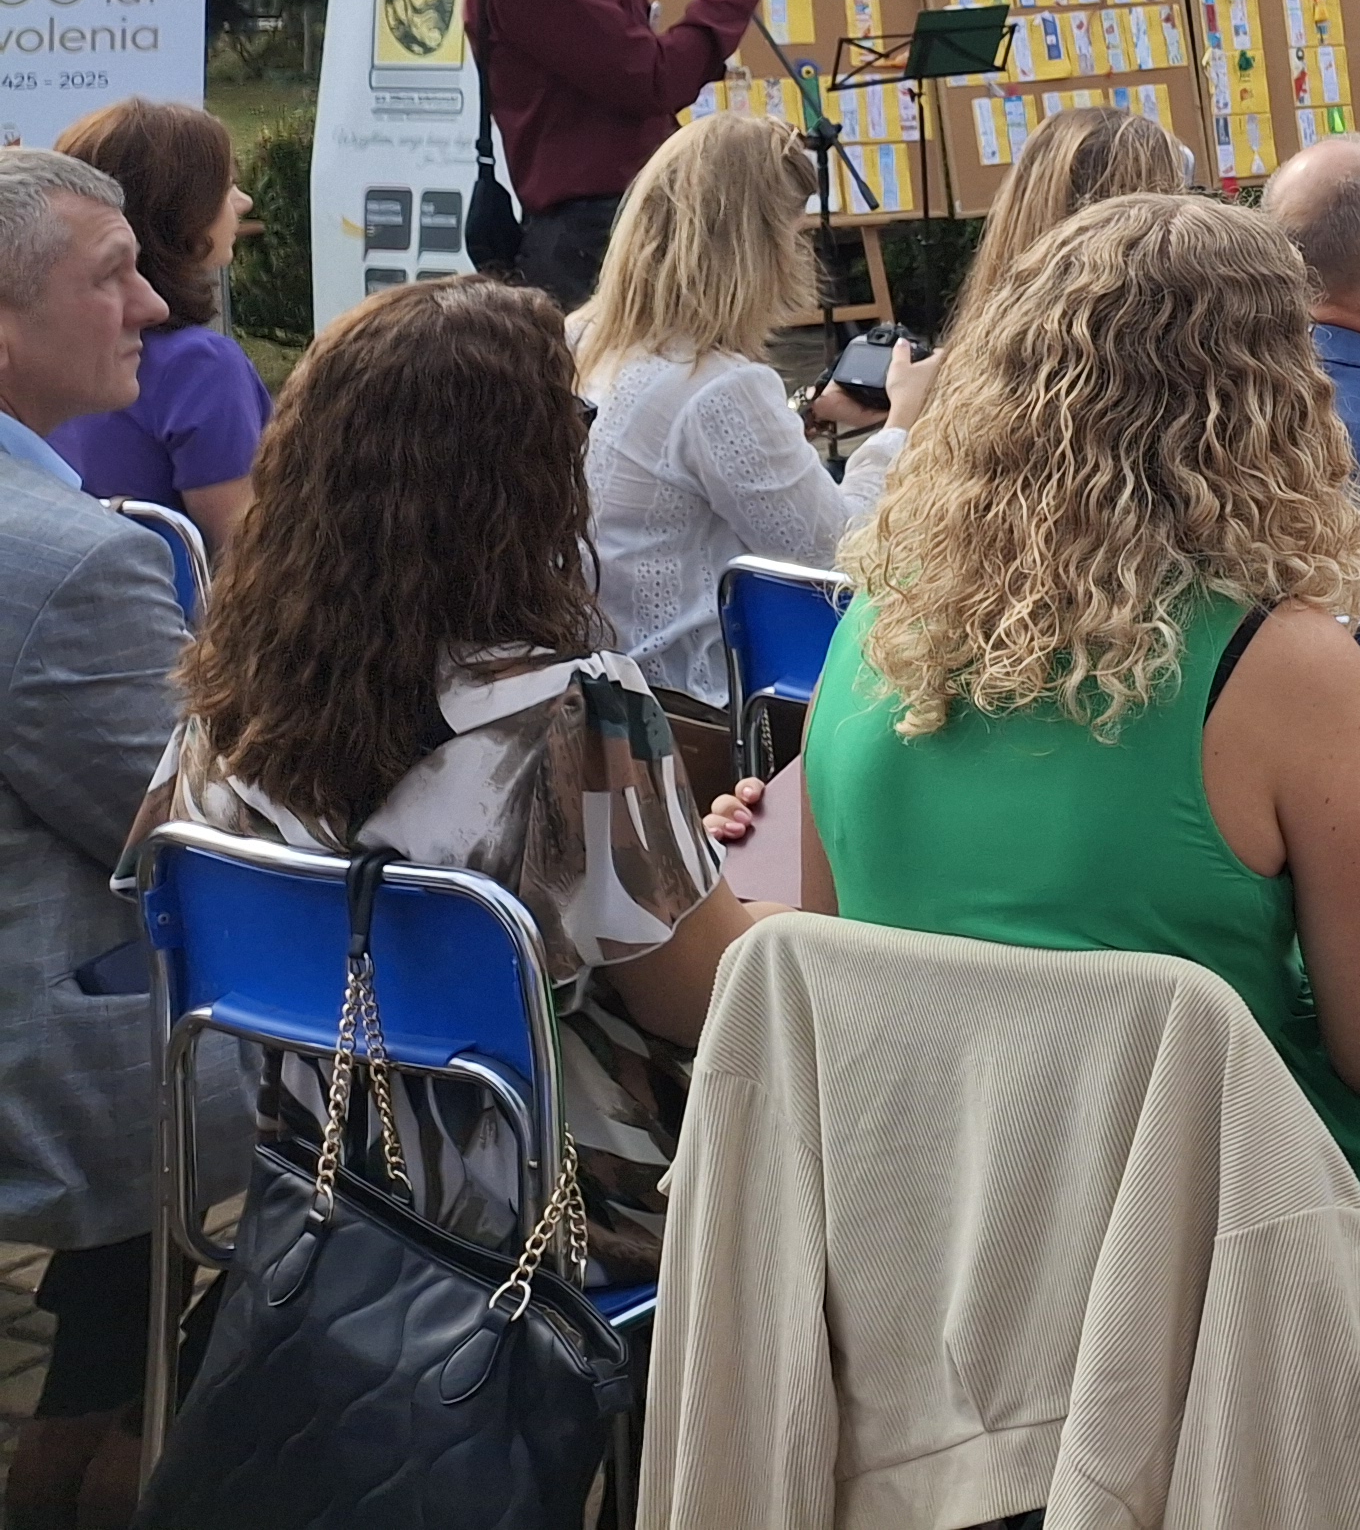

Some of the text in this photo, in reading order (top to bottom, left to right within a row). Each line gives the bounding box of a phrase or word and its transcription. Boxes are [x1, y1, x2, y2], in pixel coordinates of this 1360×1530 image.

[0, 16, 160, 53] olenia
[1, 72, 38, 90] 425
[59, 72, 109, 90] 2025
